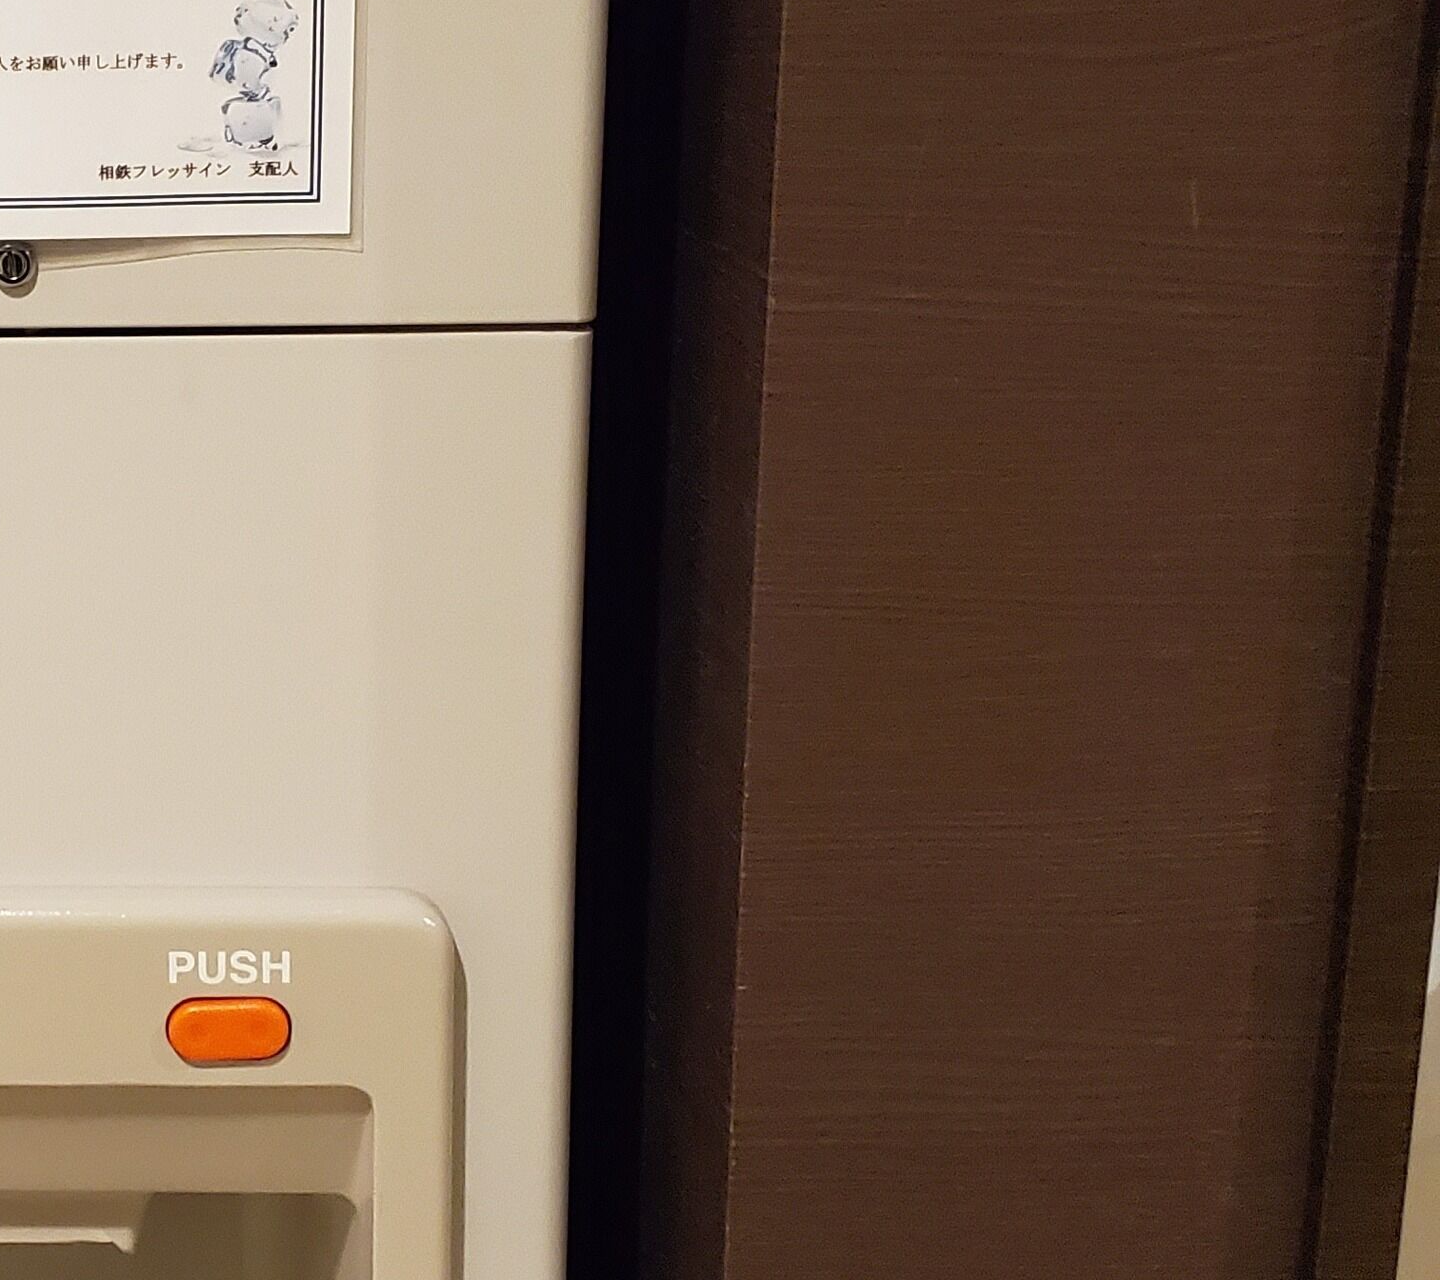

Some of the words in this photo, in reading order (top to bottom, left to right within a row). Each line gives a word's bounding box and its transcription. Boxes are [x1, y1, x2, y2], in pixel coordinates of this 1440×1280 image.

[98, 164, 231, 181] 相鉄フレッサイン
[248, 160, 299, 178] 支配人
[167, 950, 291, 984] PUSH
